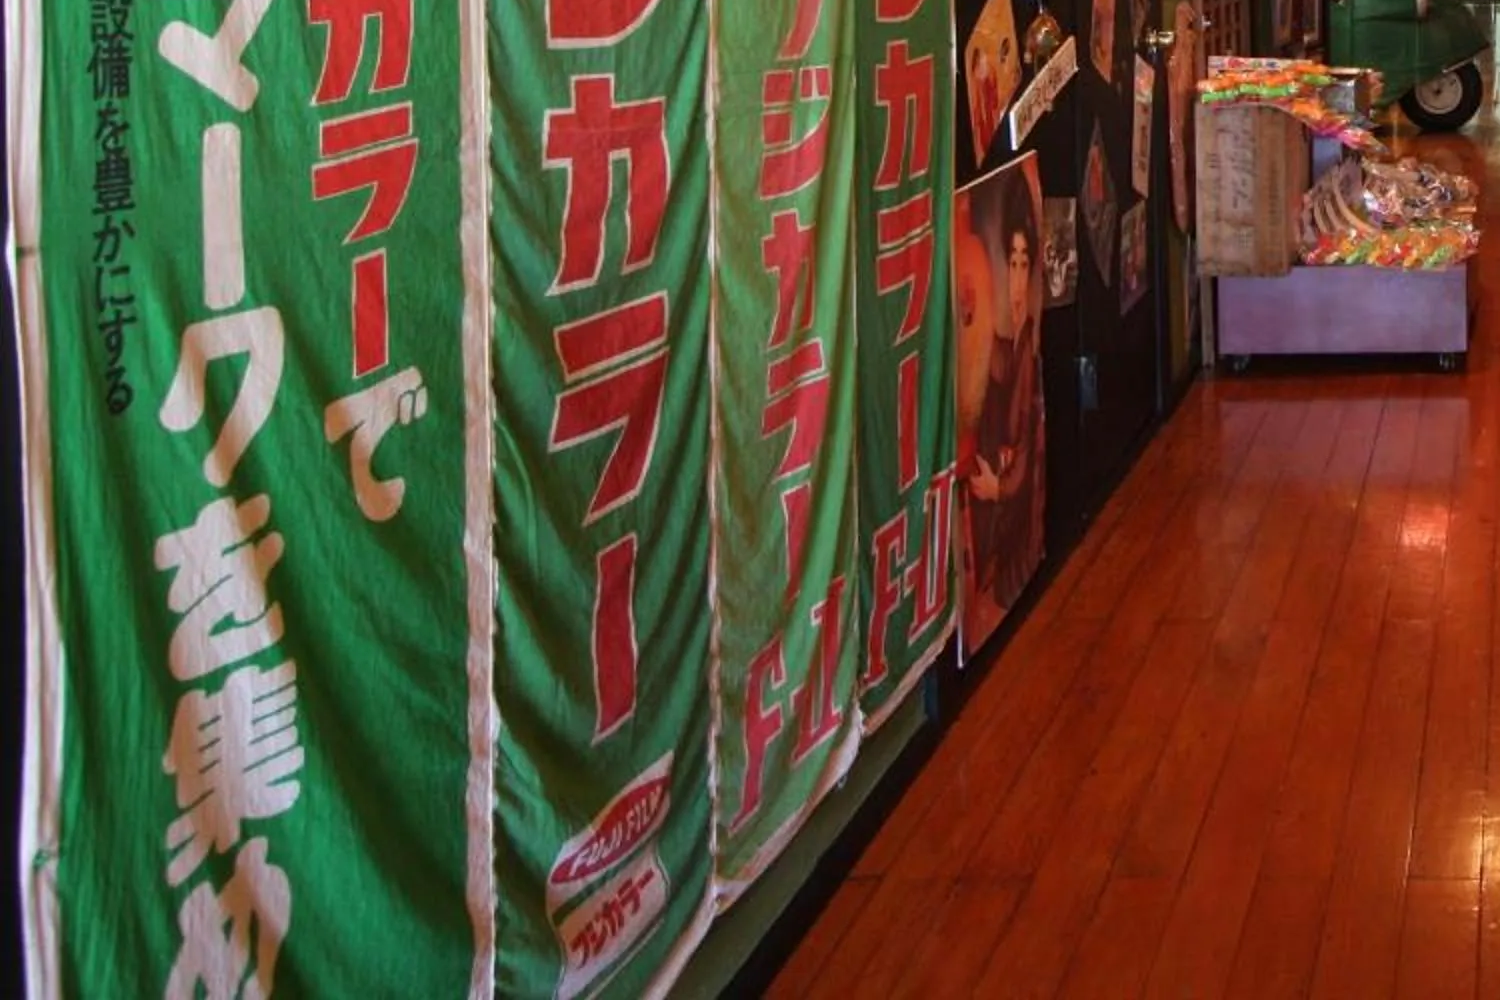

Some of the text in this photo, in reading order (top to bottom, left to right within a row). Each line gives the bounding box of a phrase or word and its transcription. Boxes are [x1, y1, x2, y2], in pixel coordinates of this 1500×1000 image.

[568, 783, 664, 878] FUJI FILM
[570, 867, 655, 971] フジカラー
